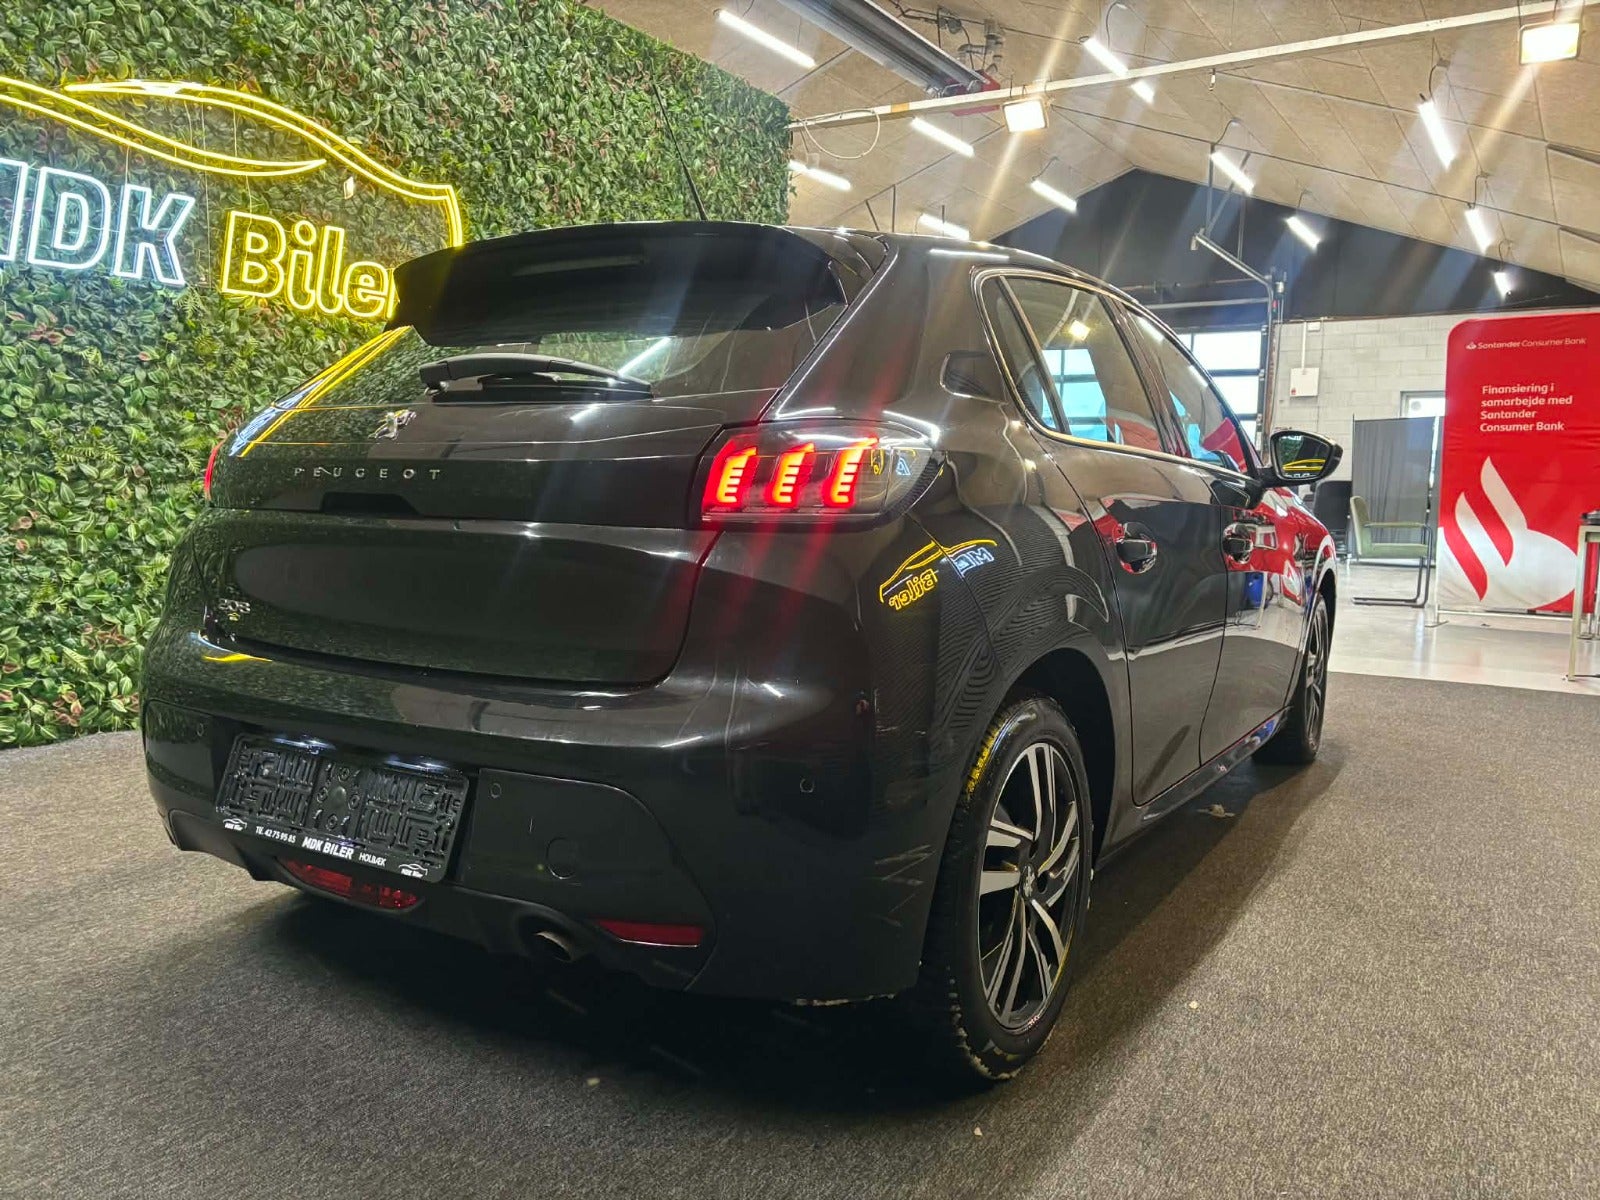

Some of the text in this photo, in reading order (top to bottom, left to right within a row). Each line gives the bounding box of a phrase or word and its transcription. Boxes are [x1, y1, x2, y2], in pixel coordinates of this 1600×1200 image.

[1478, 337, 1586, 350] Santander Consumer Bank
[1482, 384, 1548, 395] Finansiering
[1481, 395, 1573, 408] samarbejde med
[1480, 409, 1537, 419] Santander
[1479, 421, 1565, 432] Consumer Bank
[293, 466, 441, 480] PEUGEOT
[302, 836, 355, 860] MDK BILER
